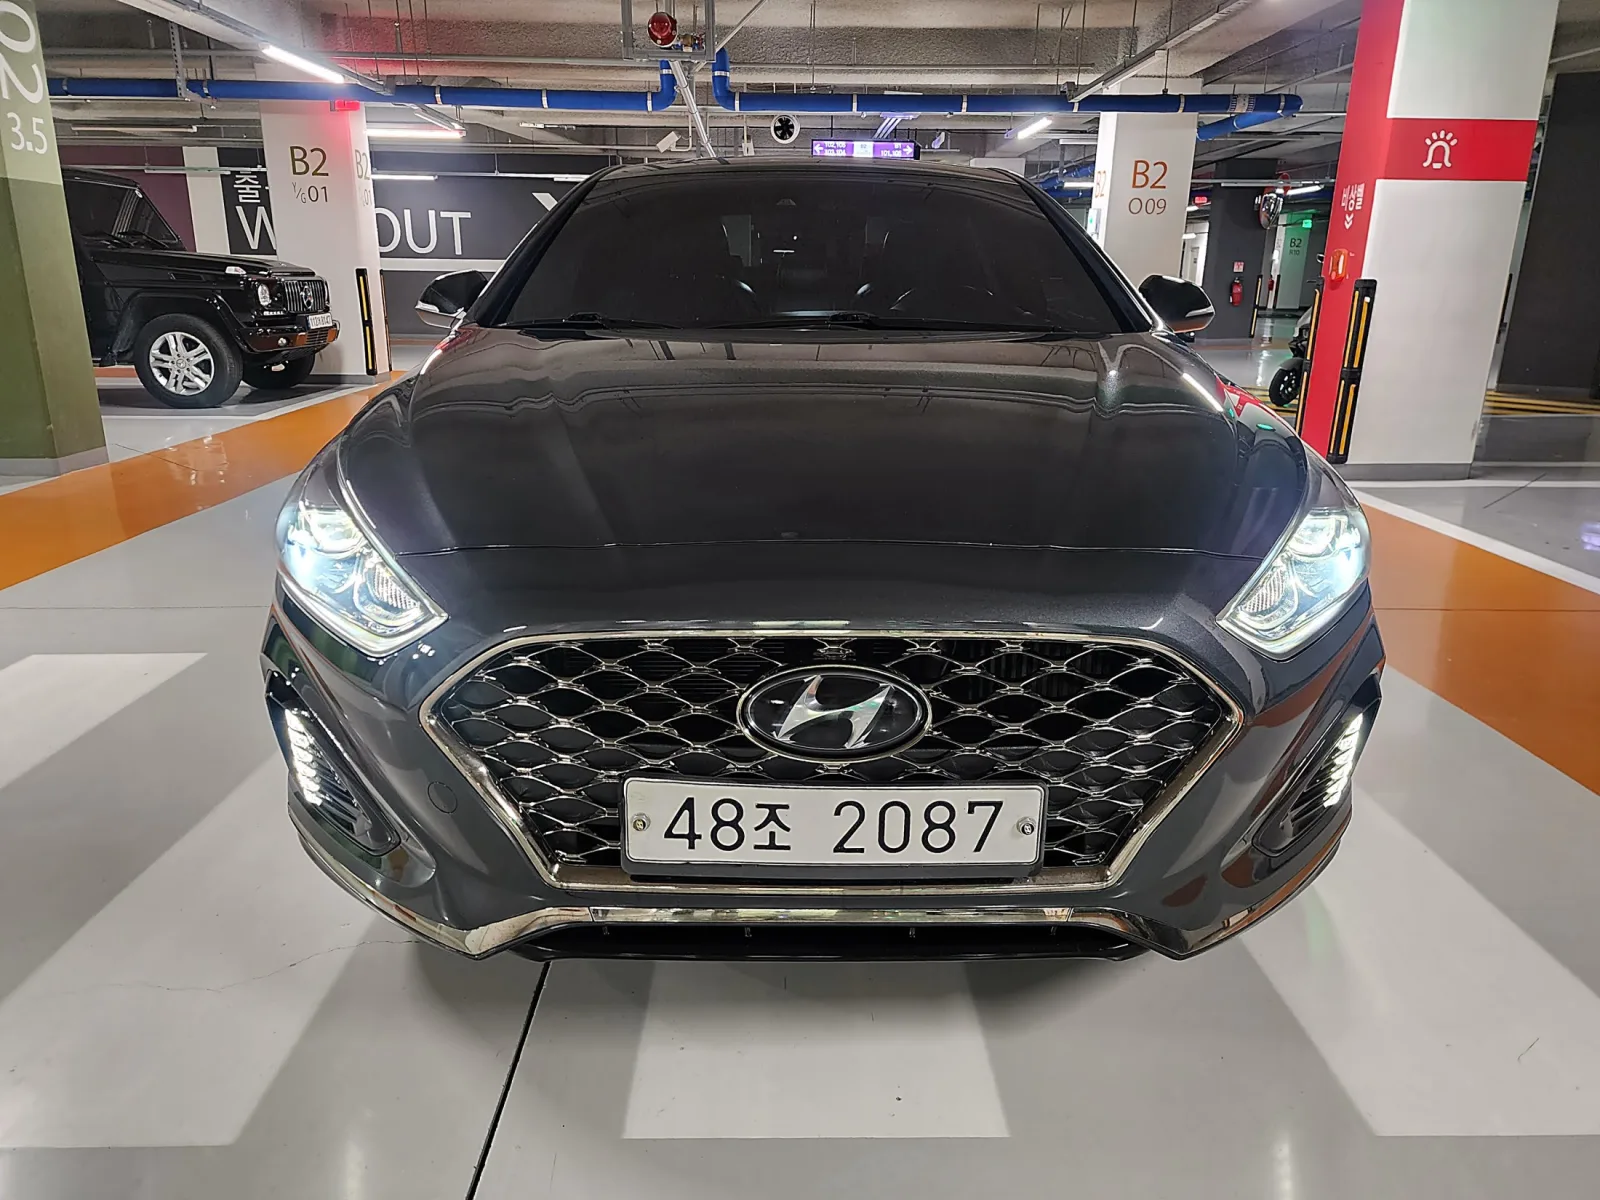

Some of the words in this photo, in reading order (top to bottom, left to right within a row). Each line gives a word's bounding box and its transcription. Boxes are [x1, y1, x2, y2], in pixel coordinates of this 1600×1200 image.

[7, 112, 48, 155] 3.5
[289, 145, 329, 177] B2
[354, 150, 371, 181] B2
[1131, 159, 1168, 189] B2
[1341, 183, 1365, 211] 비상벨
[1289, 238, 1302, 248] B2
[663, 796, 792, 852] 48조
[832, 799, 1004, 855] 2087
